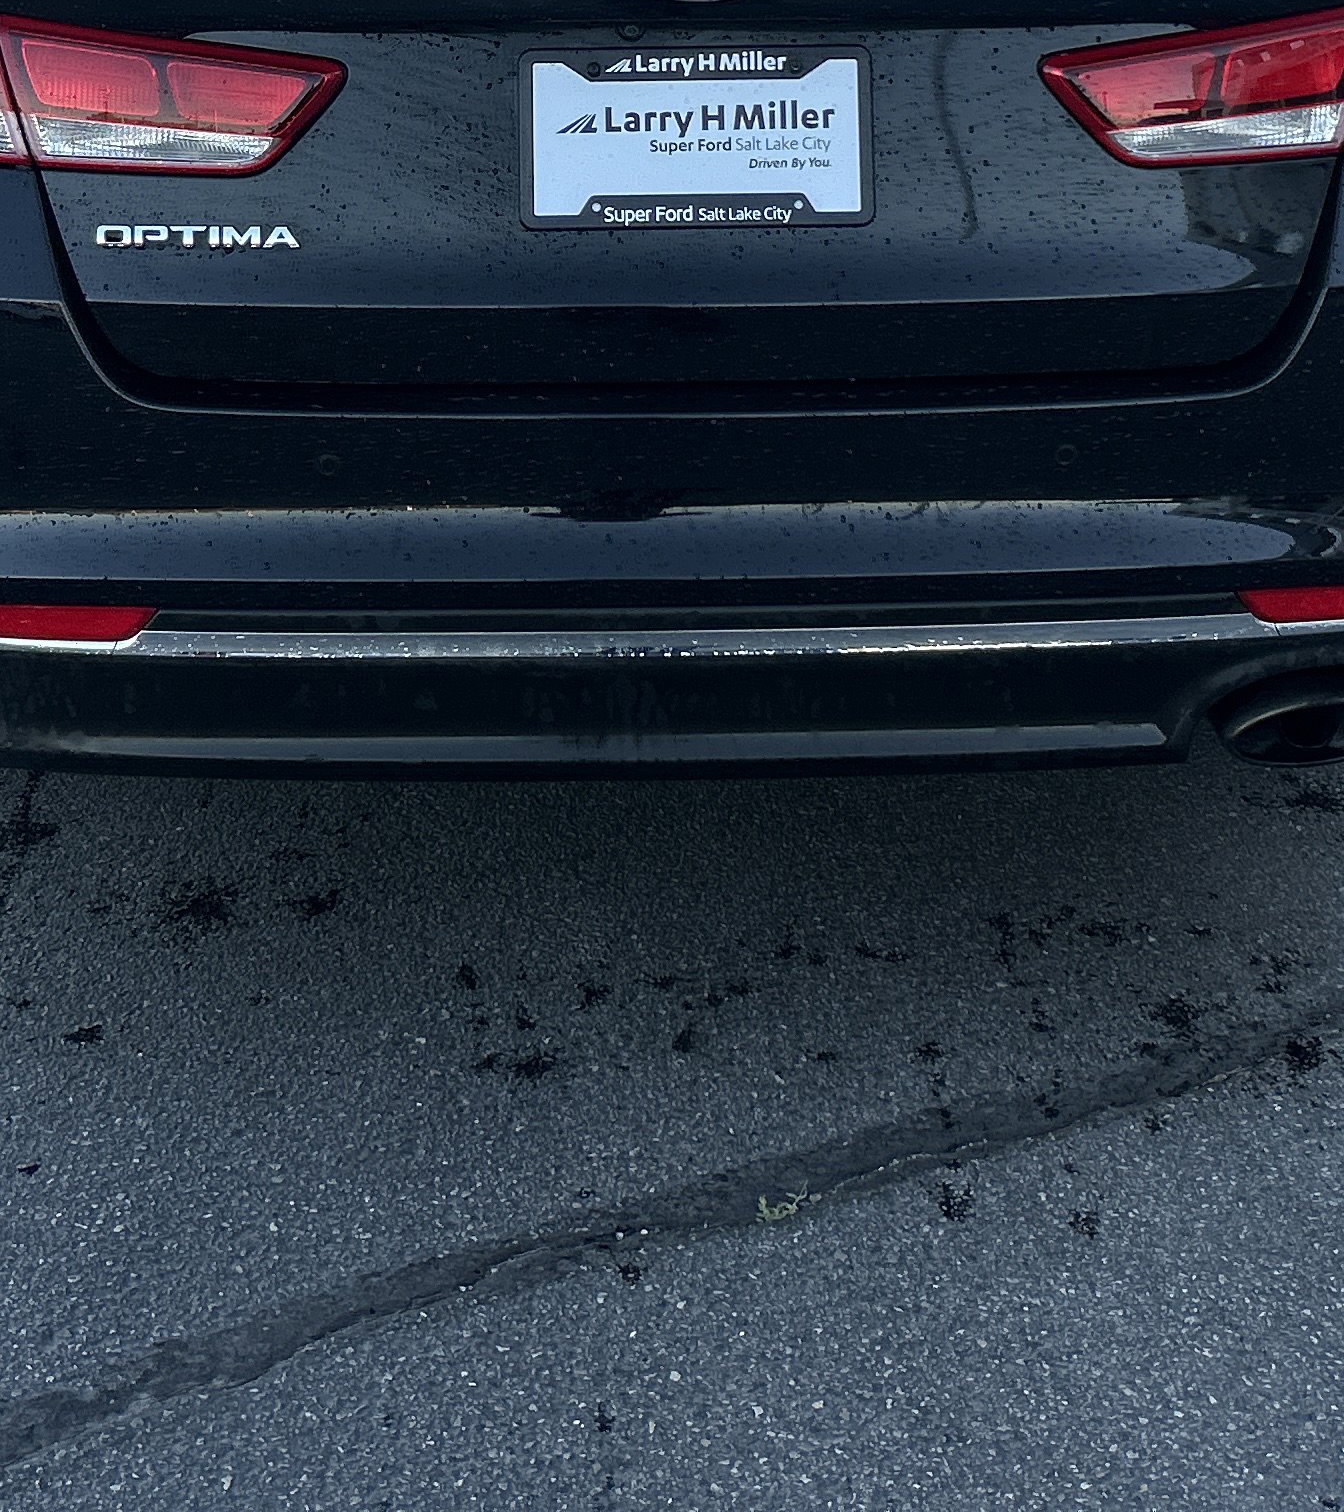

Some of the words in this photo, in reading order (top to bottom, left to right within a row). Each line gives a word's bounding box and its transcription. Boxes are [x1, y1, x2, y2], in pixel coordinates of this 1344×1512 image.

[635, 54, 695, 77] Larry
[699, 53, 715, 71] H
[720, 51, 787, 71] Miller
[605, 107, 694, 138] Larry
[701, 105, 725, 131] H
[733, 100, 835, 131] Miller
[649, 140, 694, 155] Super
[698, 137, 732, 151] Ford
[736, 137, 762, 151] Salt
[765, 136, 799, 151] Lake
[802, 136, 831, 152] City
[749, 157, 788, 169] Driven
[791, 157, 805, 170] By
[604, 206, 652, 226] Super
[656, 205, 693, 221] Ford
[698, 206, 726, 221] Salt
[728, 206, 762, 221] Lake
[764, 205, 792, 223] City
[96, 225, 301, 248] OPTIMA
